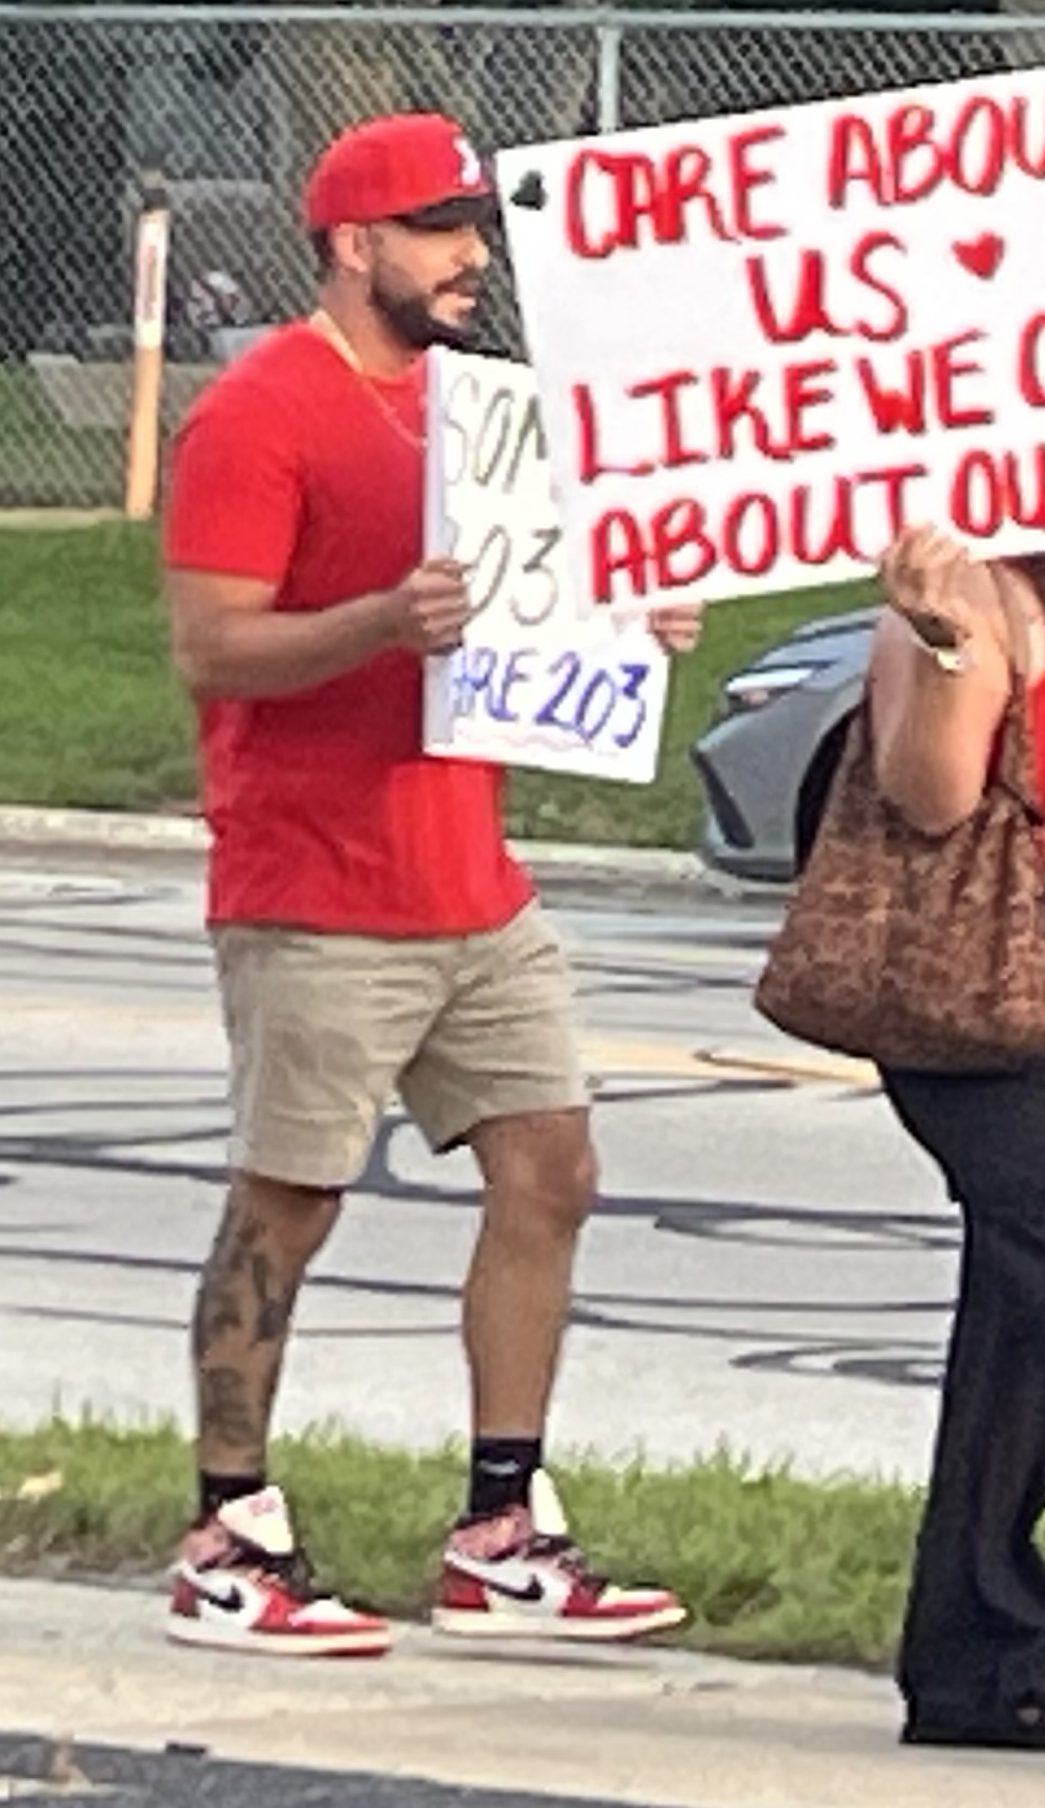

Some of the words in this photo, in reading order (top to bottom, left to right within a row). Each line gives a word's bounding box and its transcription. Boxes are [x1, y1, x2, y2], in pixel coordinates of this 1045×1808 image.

[566, 125, 787, 259] CARE
[746, 231, 908, 342] US
[573, 358, 839, 483] LIKE
[856, 330, 992, 435] WE
[446, 517, 562, 626] 03
[591, 464, 925, 604] ABOUT
[535, 651, 649, 748] 203
